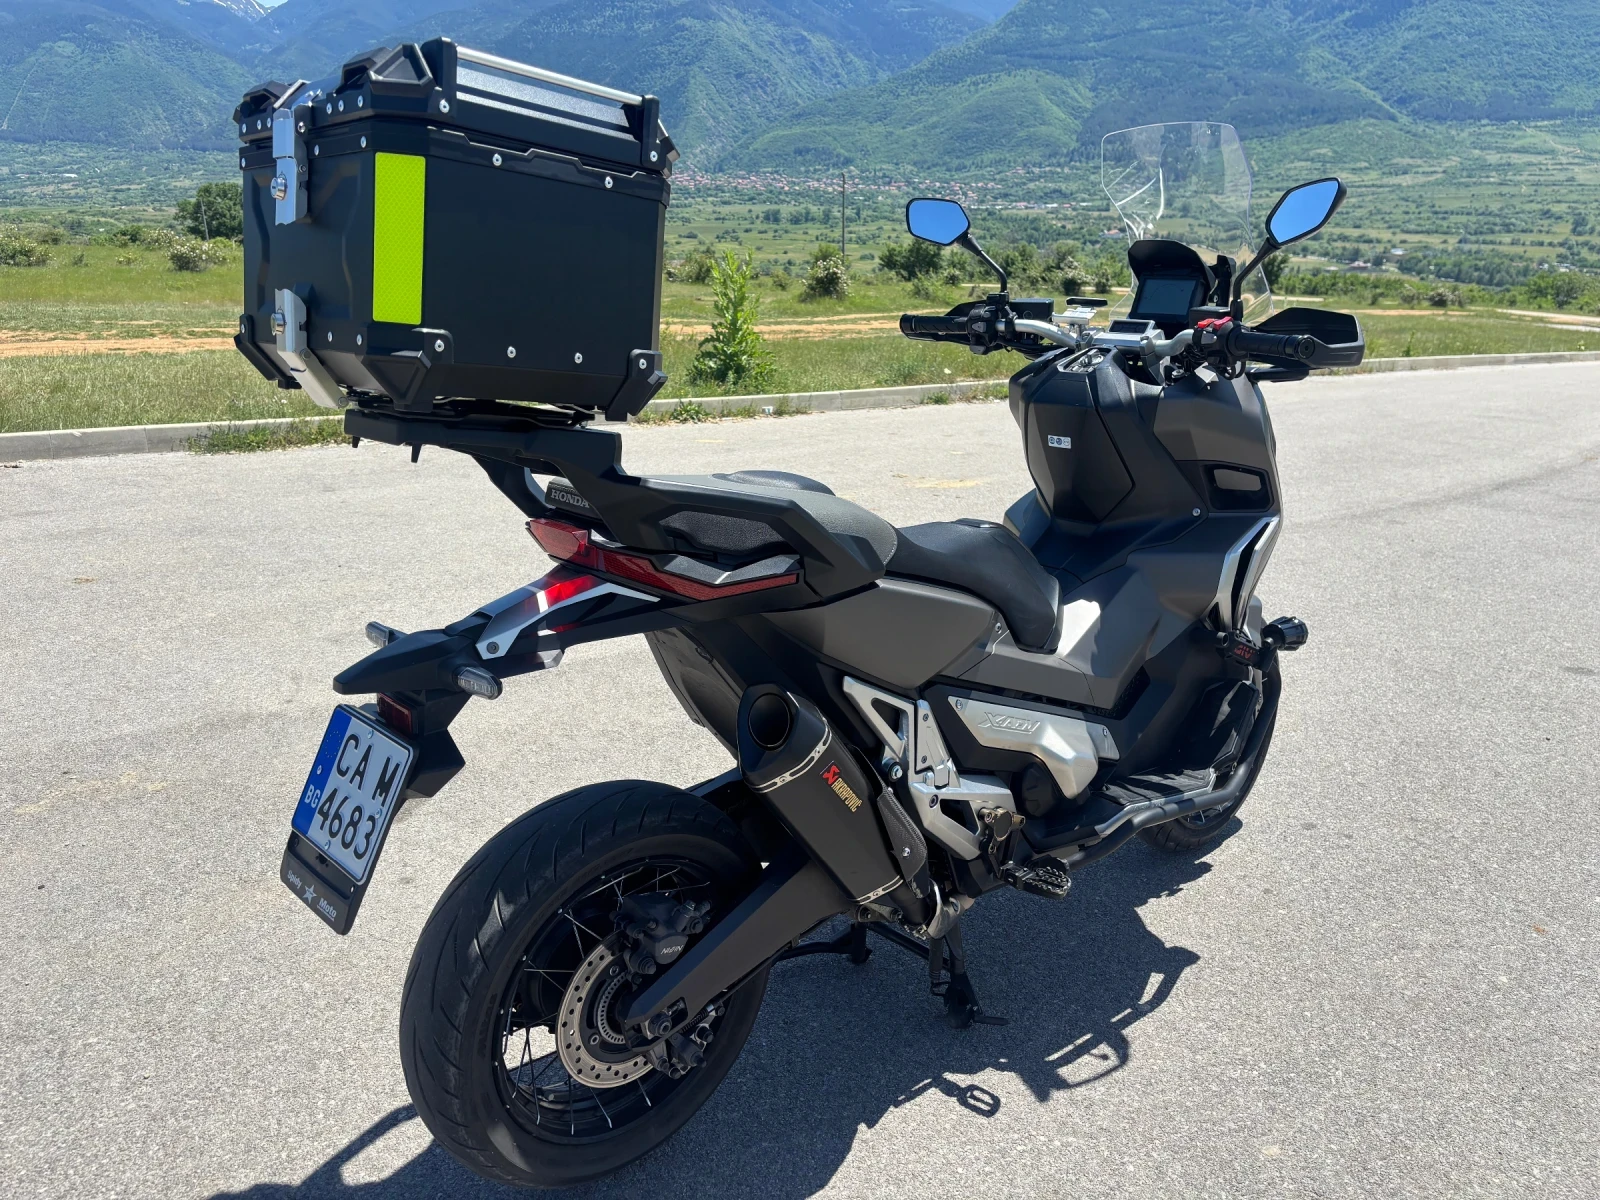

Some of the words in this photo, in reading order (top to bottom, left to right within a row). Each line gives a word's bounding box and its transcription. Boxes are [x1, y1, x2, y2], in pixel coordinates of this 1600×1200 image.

[550, 489, 590, 508] HONDA
[336, 733, 372, 791] CA
[371, 756, 400, 808] M
[304, 784, 321, 809] BG
[317, 788, 376, 860] 4683
[318, 897, 337, 918] Moto
